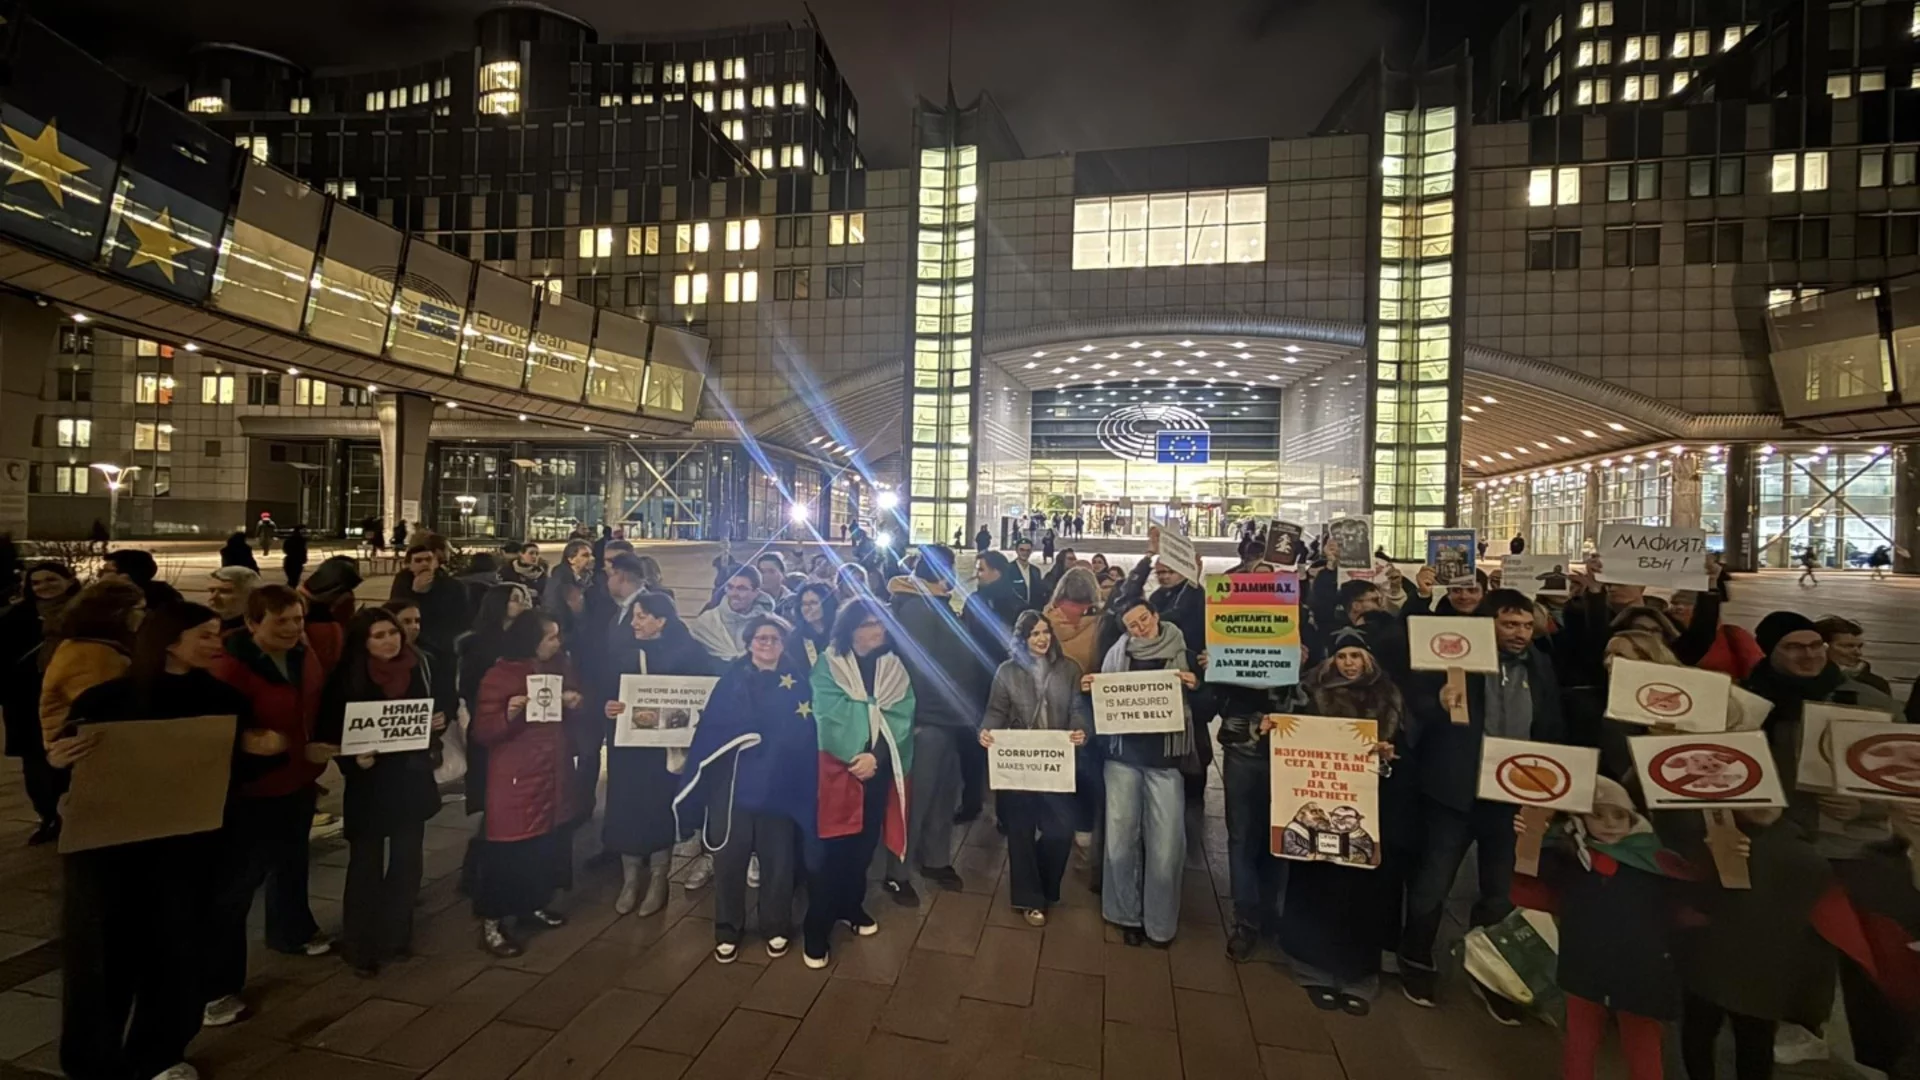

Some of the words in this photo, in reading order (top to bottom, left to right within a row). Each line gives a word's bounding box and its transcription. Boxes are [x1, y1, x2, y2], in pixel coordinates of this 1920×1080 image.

[476, 312, 568, 350] European
[473, 335, 578, 373] Parliament
[1216, 582, 1230, 593] АЗ
[1233, 582, 1296, 593] ЗАМИНАХ.
[1215, 614, 1271, 623] РОДИТЕЛИТЕ
[1225, 625, 1275, 633] ОСТАНАХА.
[1251, 660, 1291, 668] ДОСТОЕН
[1102, 683, 1173, 693] CORRUPTION
[1105, 698, 1114, 707] IS
[1116, 696, 1169, 707] MEASURED
[382, 703, 429, 715] НЯМА
[1106, 712, 1118, 721] BY
[1120, 711, 1140, 720] THE
[1143, 710, 1173, 719] BELLY
[348, 717, 375, 731] ДА
[377, 714, 428, 727] СТАНЕ
[381, 725, 427, 738] ТАКА!
[997, 749, 1065, 758] CORRUPTION
[1274, 747, 1349, 761] ИЗГОНИХТЕ
[997, 762, 1024, 770] MAKES
[1026, 763, 1042, 771] YOU
[1044, 763, 1061, 772] FAT
[1284, 758, 1315, 769] СЕГА
[1321, 761, 1329, 769] Е
[1333, 763, 1365, 772] ВАШ
[1311, 771, 1337, 780] РЕД
[1307, 780, 1325, 789] ДА
[1331, 782, 1348, 791] СИ
[1292, 788, 1358, 802] ТРЪГНЕТЕ
